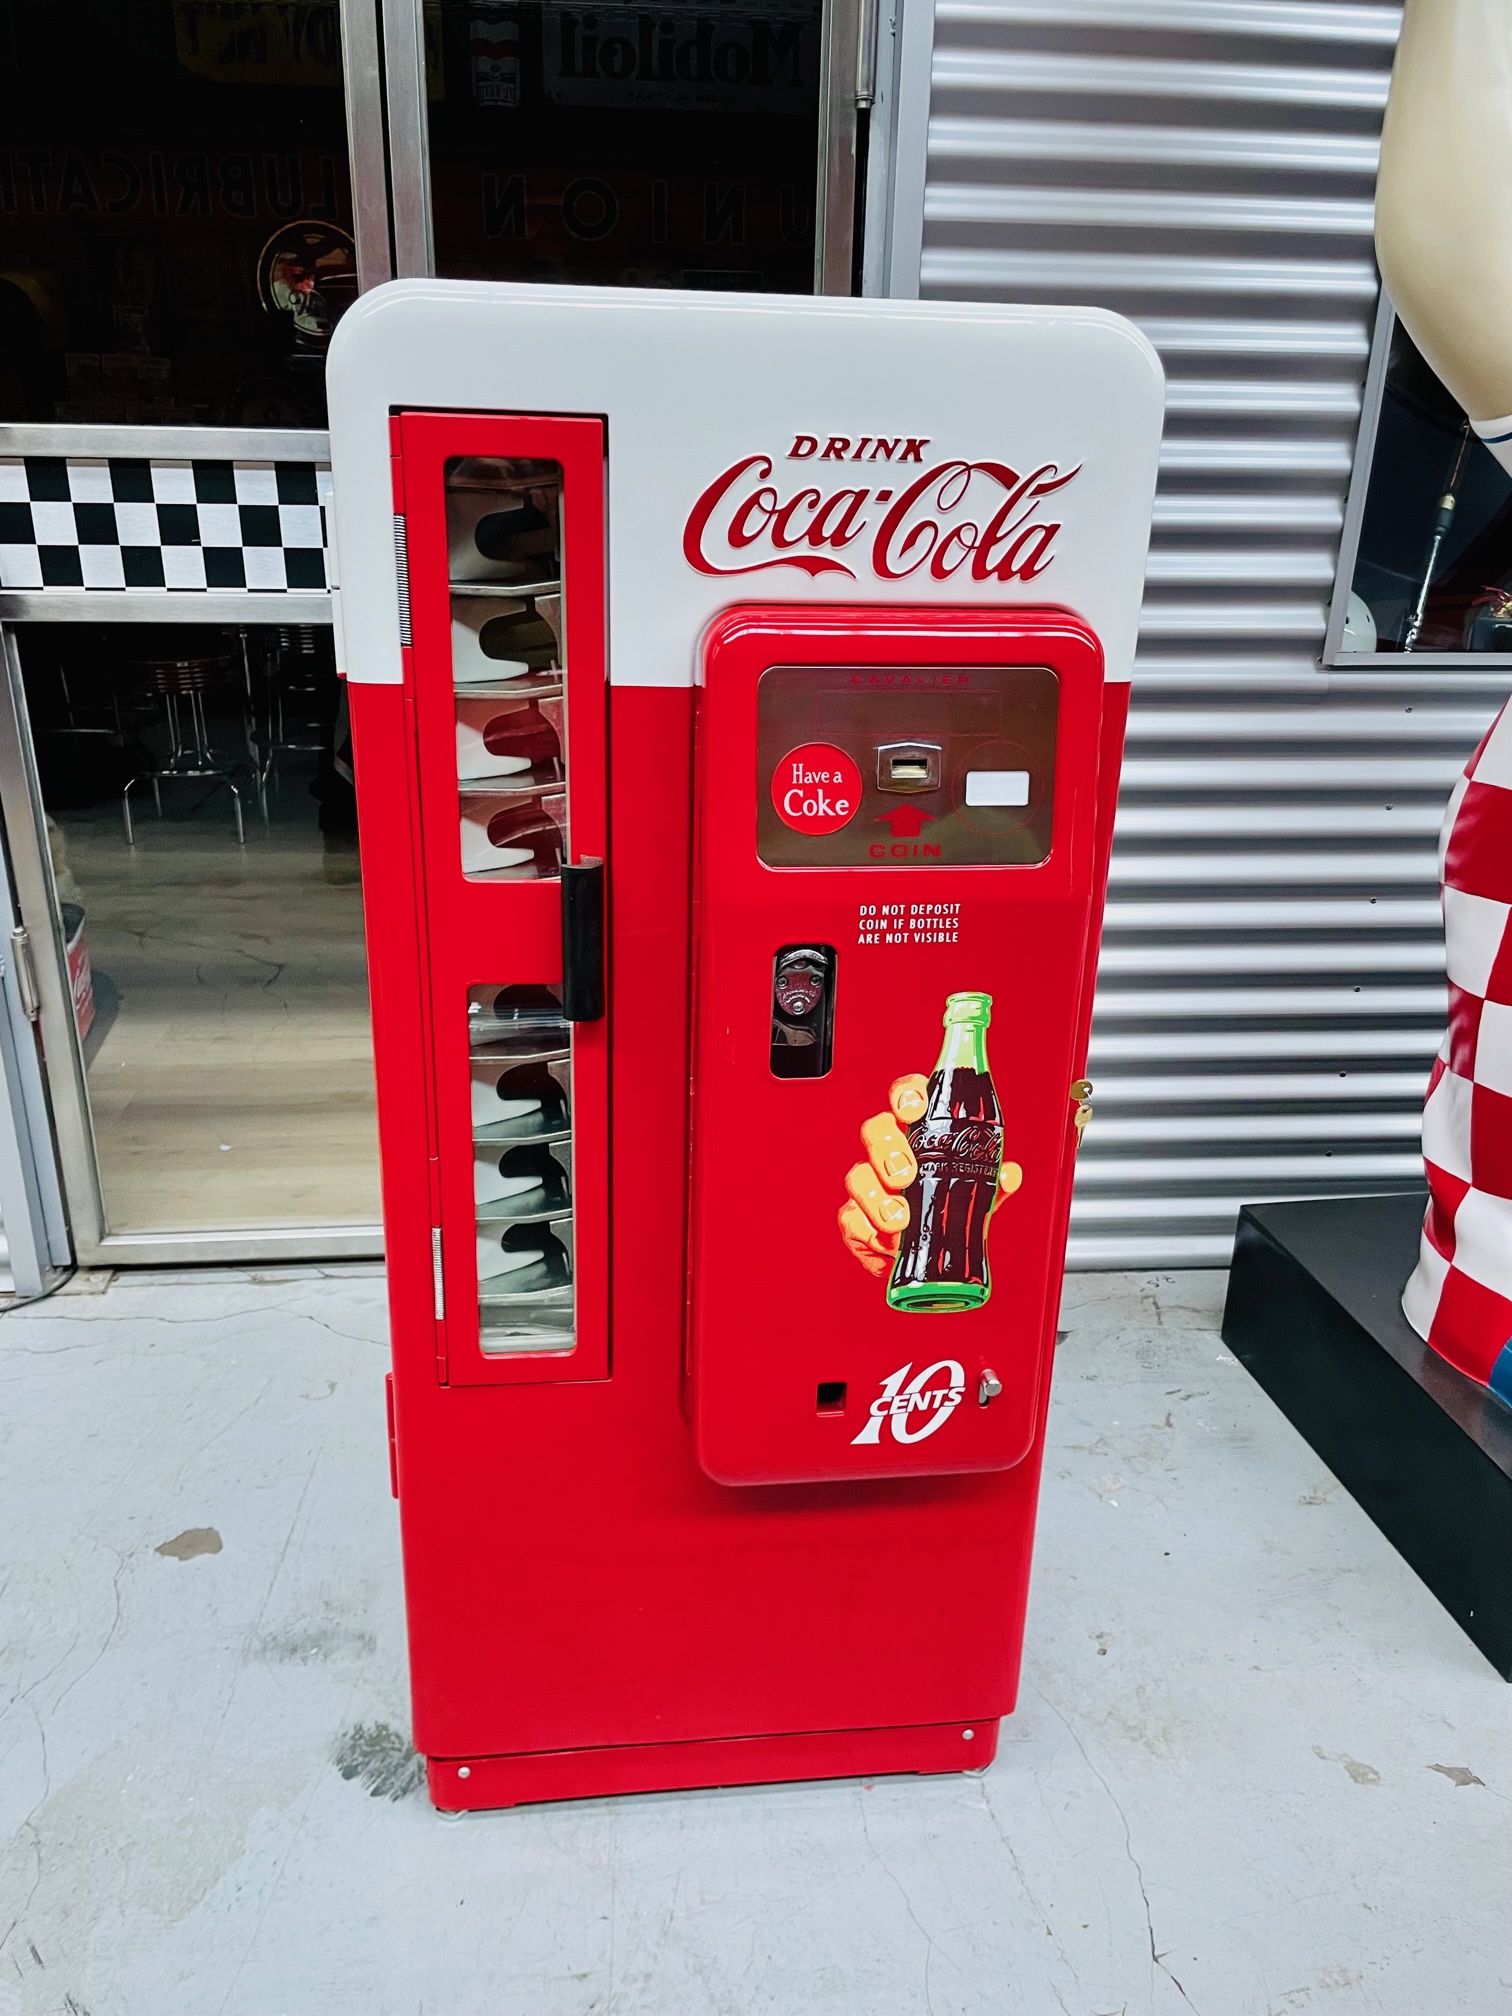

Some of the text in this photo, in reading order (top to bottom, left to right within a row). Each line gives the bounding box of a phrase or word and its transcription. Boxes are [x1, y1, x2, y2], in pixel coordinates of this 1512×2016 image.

[787, 434, 932, 463] DRINK
[682, 453, 1085, 583] Coca-Cola
[850, 674, 970, 686] CAVALIER
[791, 763, 844, 785] Have a
[783, 788, 850, 817] Coke
[868, 843, 942, 860] COIN
[859, 903, 961, 916] DO NOT DEPOSIT
[858, 917, 960, 931] COIN IF BOTTLES
[857, 931, 959, 945] ARE NOT VISIBLE
[850, 1360, 966, 1446] 10
[869, 1386, 967, 1418] CENTS
